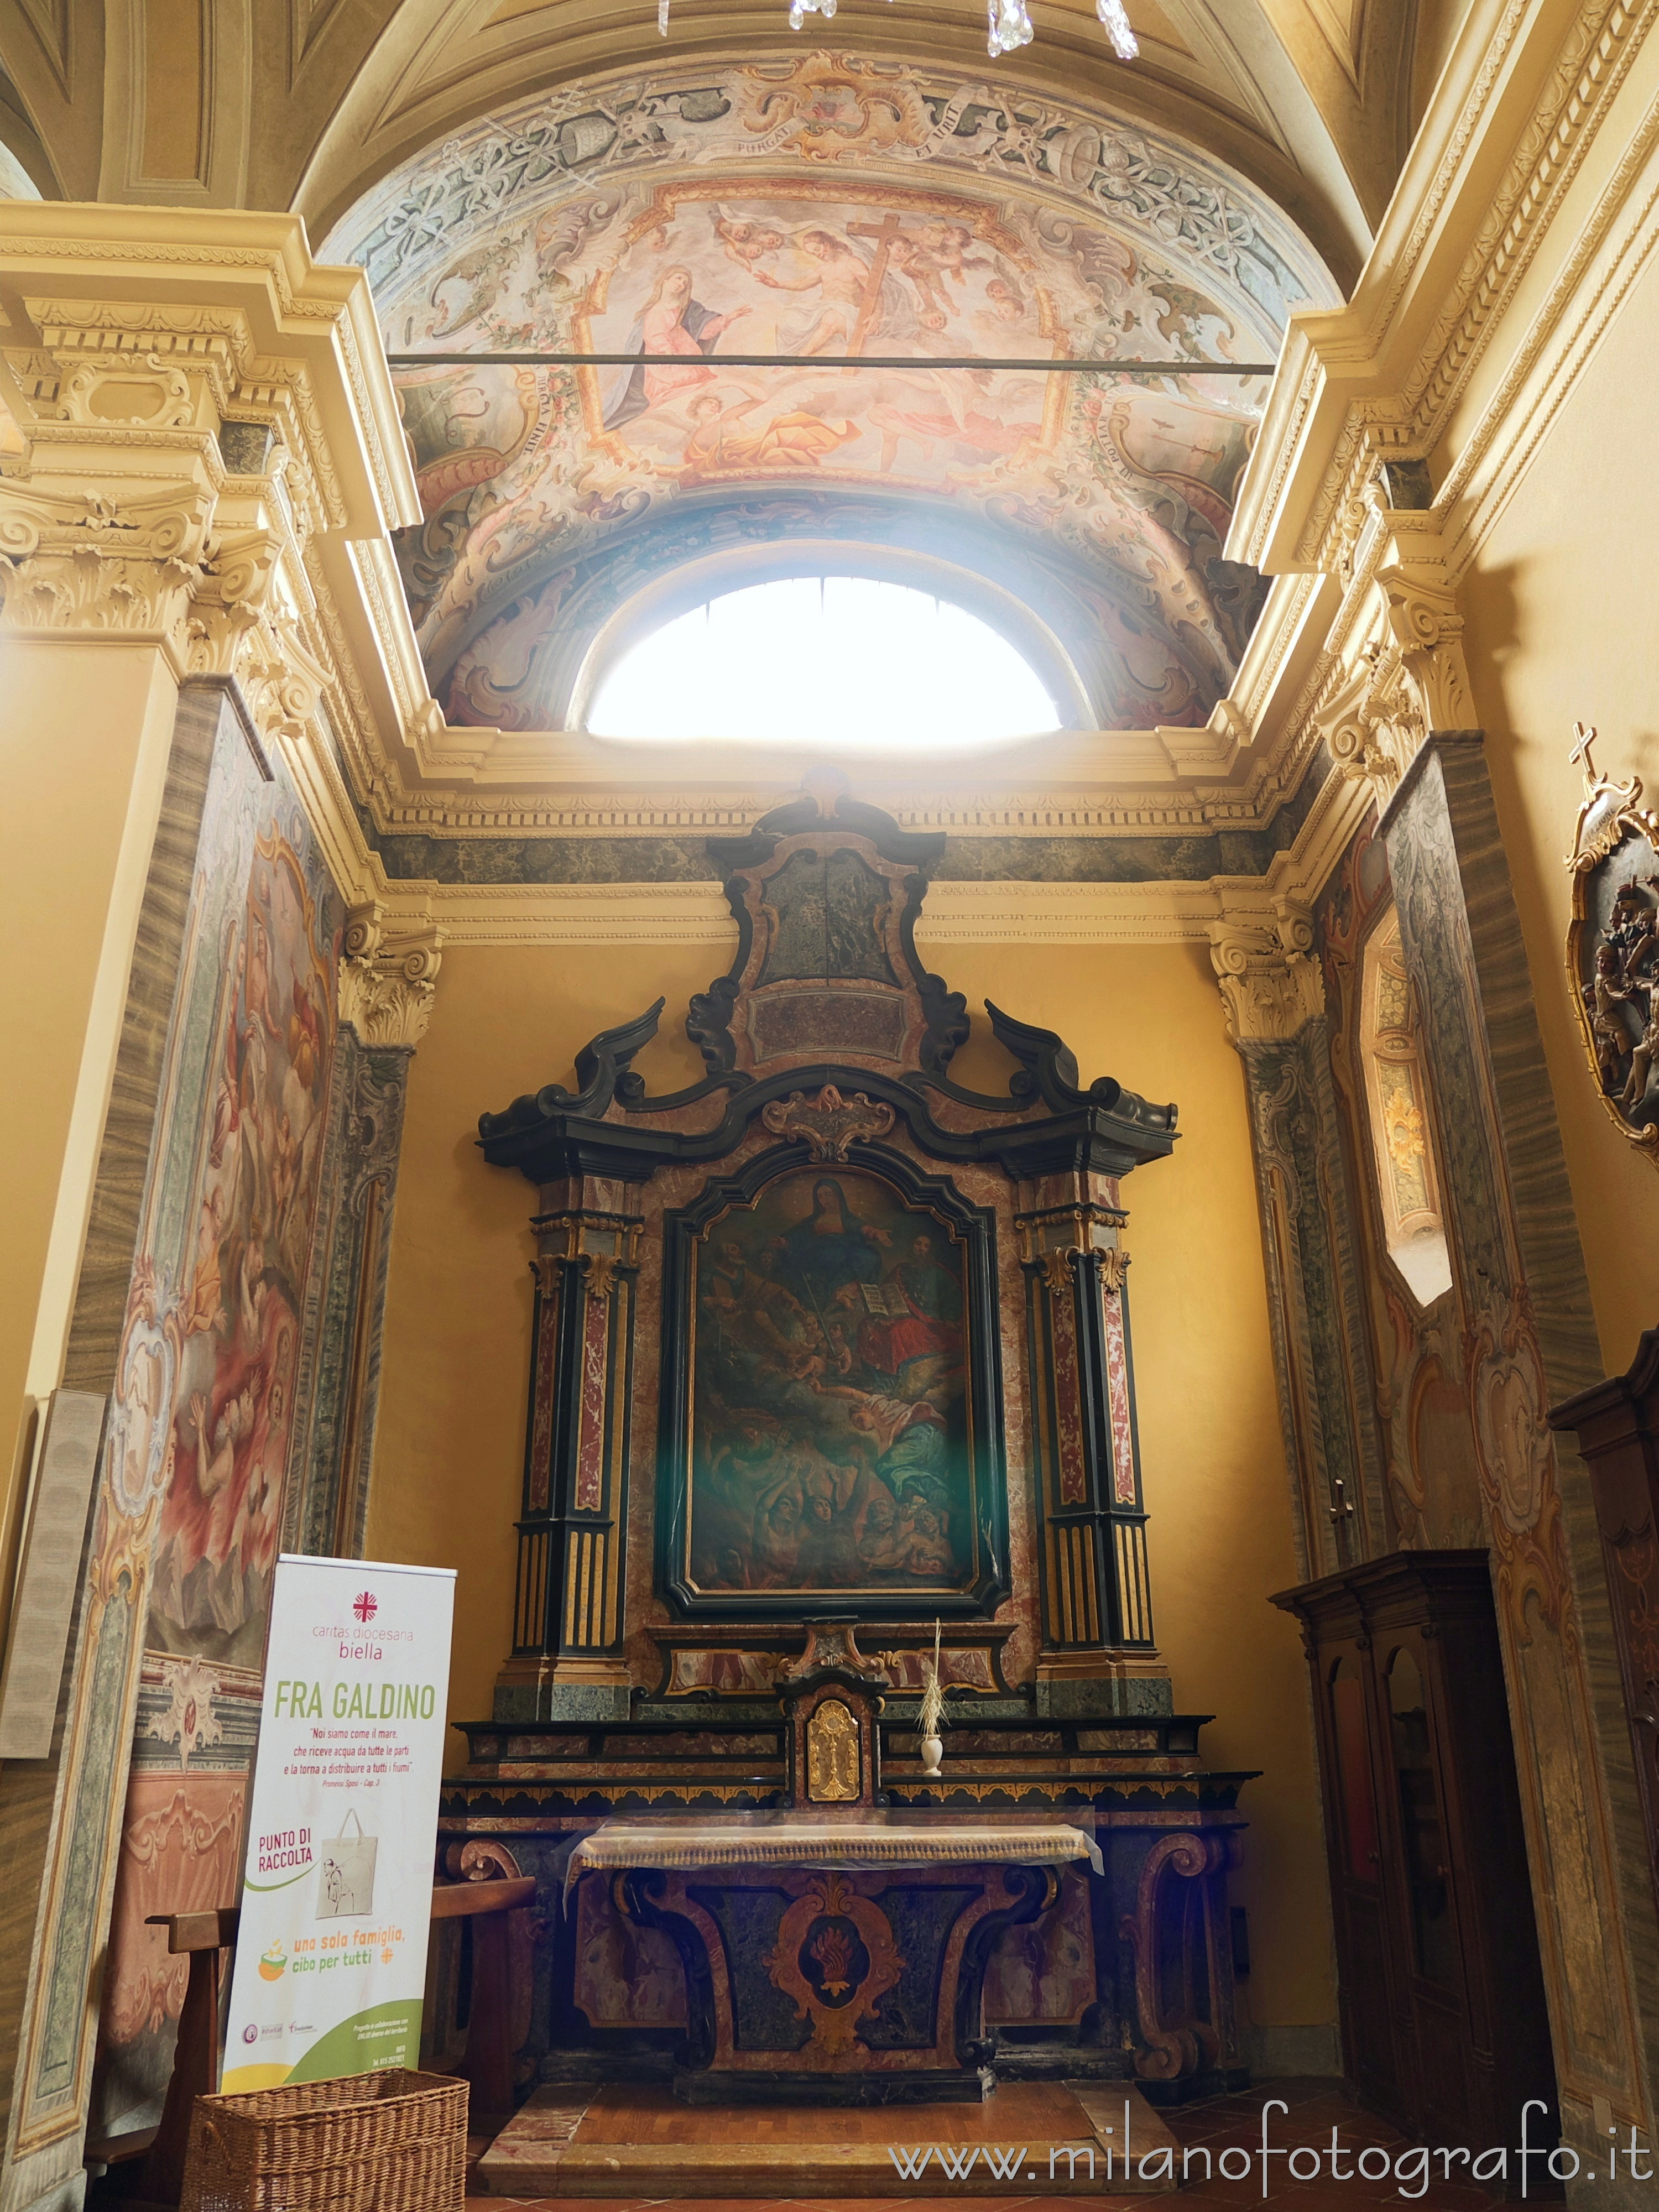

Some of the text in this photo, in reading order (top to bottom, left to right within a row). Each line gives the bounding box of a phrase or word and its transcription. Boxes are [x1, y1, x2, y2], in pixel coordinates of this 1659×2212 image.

[312, 1624, 414, 1642] caritas diocesana
[339, 1641, 382, 1660] biella
[274, 1681, 435, 1719] FRA GALDINO
[327, 1728, 348, 1739] siamo
[351, 1730, 370, 1739] come
[372, 1728, 377, 1739] il
[294, 1745, 410, 1759] che riceve acqua da tutte le parti
[284, 1766, 289, 1775] e
[291, 1764, 298, 1775] la
[300, 1764, 320, 1775] torna
[322, 1766, 327, 1774] a
[328, 1762, 364, 1774] distribuire
[373, 1762, 388, 1773] tutti
[345, 1779, 359, 1788] Sposi
[259, 1827, 311, 1853] PUNTO DI
[258, 1846, 312, 1873] RACCOLTA
[294, 1924, 405, 1953] una sola famiglia,
[292, 1948, 372, 1974] cibo per tutti
